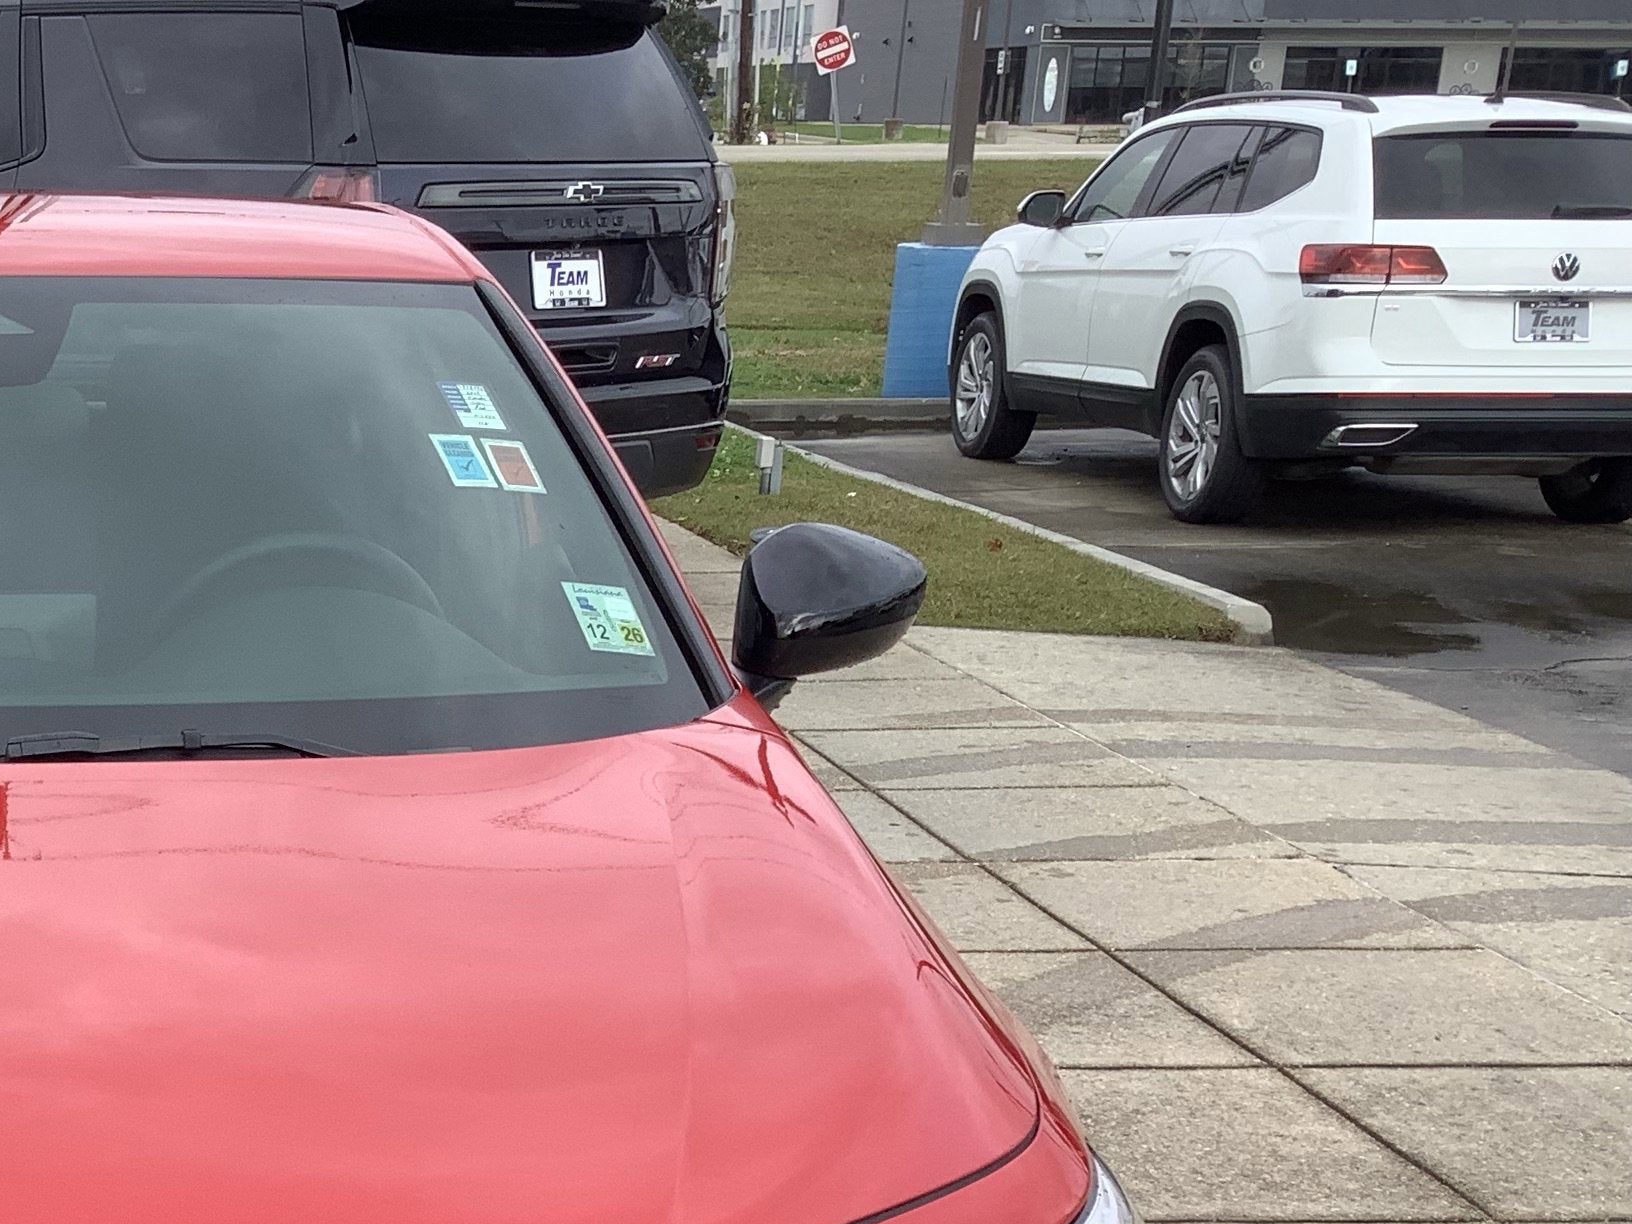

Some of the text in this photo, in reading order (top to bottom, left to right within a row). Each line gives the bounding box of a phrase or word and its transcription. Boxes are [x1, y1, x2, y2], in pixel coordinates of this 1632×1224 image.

[547, 262, 588, 287] TEAM
[549, 288, 590, 297] Honda
[1531, 309, 1576, 327] TEAM
[587, 623, 644, 643] 12 26
